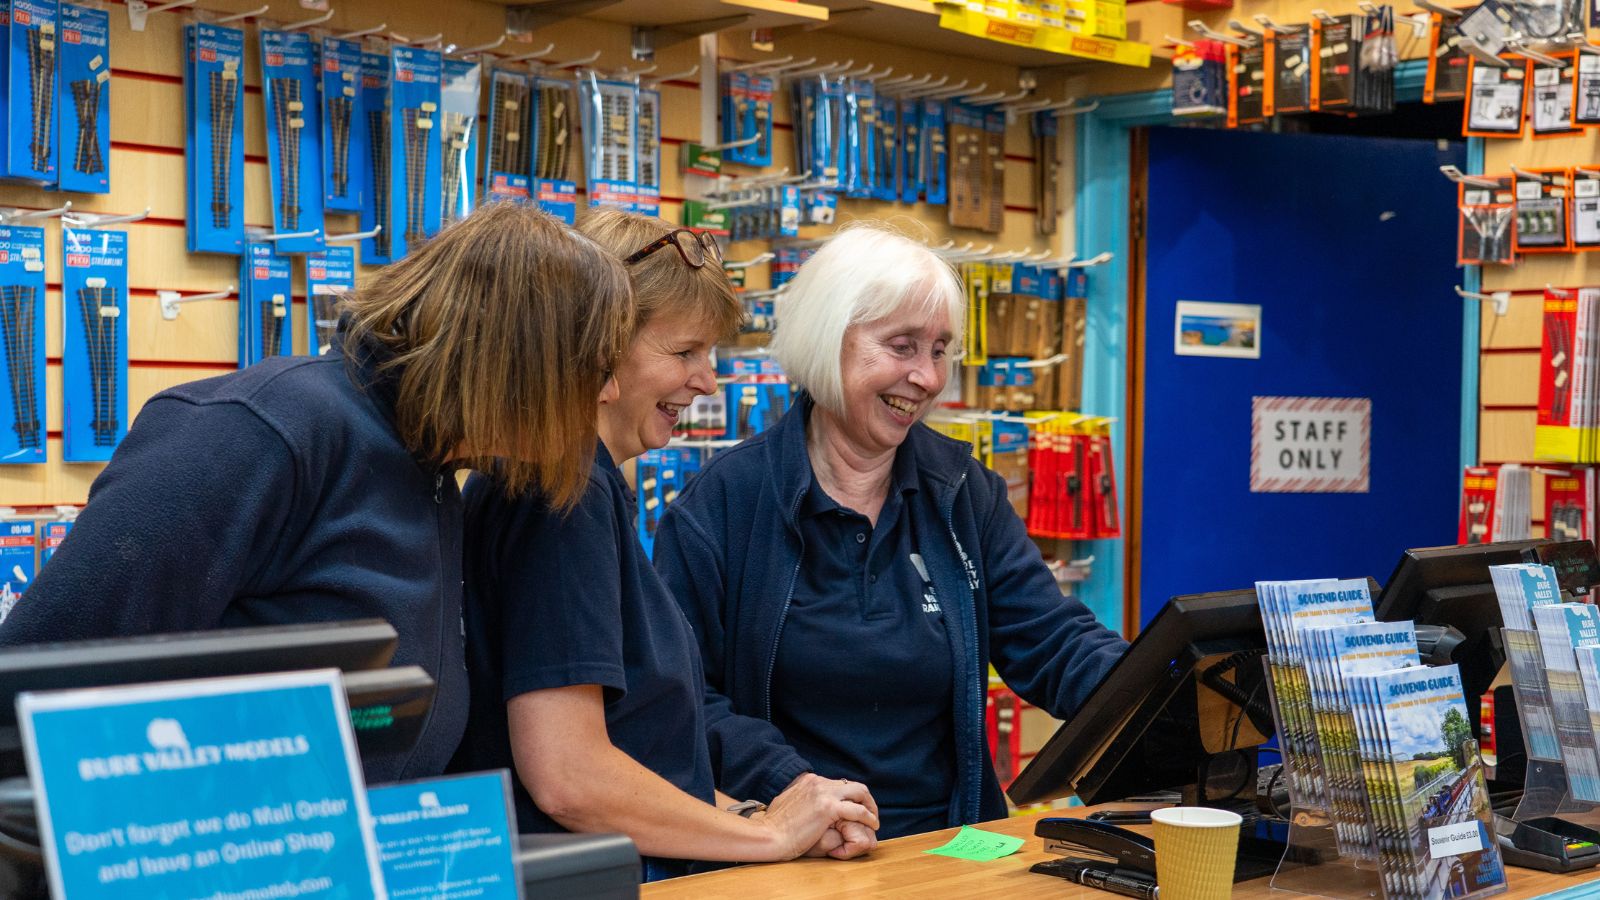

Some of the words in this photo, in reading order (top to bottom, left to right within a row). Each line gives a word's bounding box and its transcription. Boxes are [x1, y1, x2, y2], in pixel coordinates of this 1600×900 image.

[1275, 421, 1348, 441] STAFF
[1279, 448, 1342, 470] ONLY
[1298, 590, 1337, 606] SOUVENIR
[1338, 589, 1363, 602] GUIDE
[1534, 590, 1553, 598] VALLEY
[1345, 634, 1384, 648] SOUVENIR
[1385, 632, 1410, 645] GUIDE
[1579, 629, 1597, 638] VALLEY
[1389, 681, 1427, 697] SOUVENIR
[1428, 676, 1454, 690] GUIDE
[142, 745, 221, 771] VALLEY
[224, 734, 309, 762] MODELS
[64, 827, 125, 855] Don't
[127, 820, 191, 846] forget
[194, 816, 222, 834] we
[224, 812, 250, 831] do
[252, 802, 294, 826] Mail
[296, 798, 348, 820] Order
[1450, 832, 1467, 842] Guide
[99, 861, 139, 884] and
[140, 852, 192, 877] have
[194, 848, 220, 868] an
[220, 840, 285, 864] Online
[286, 831, 335, 853] Shop
